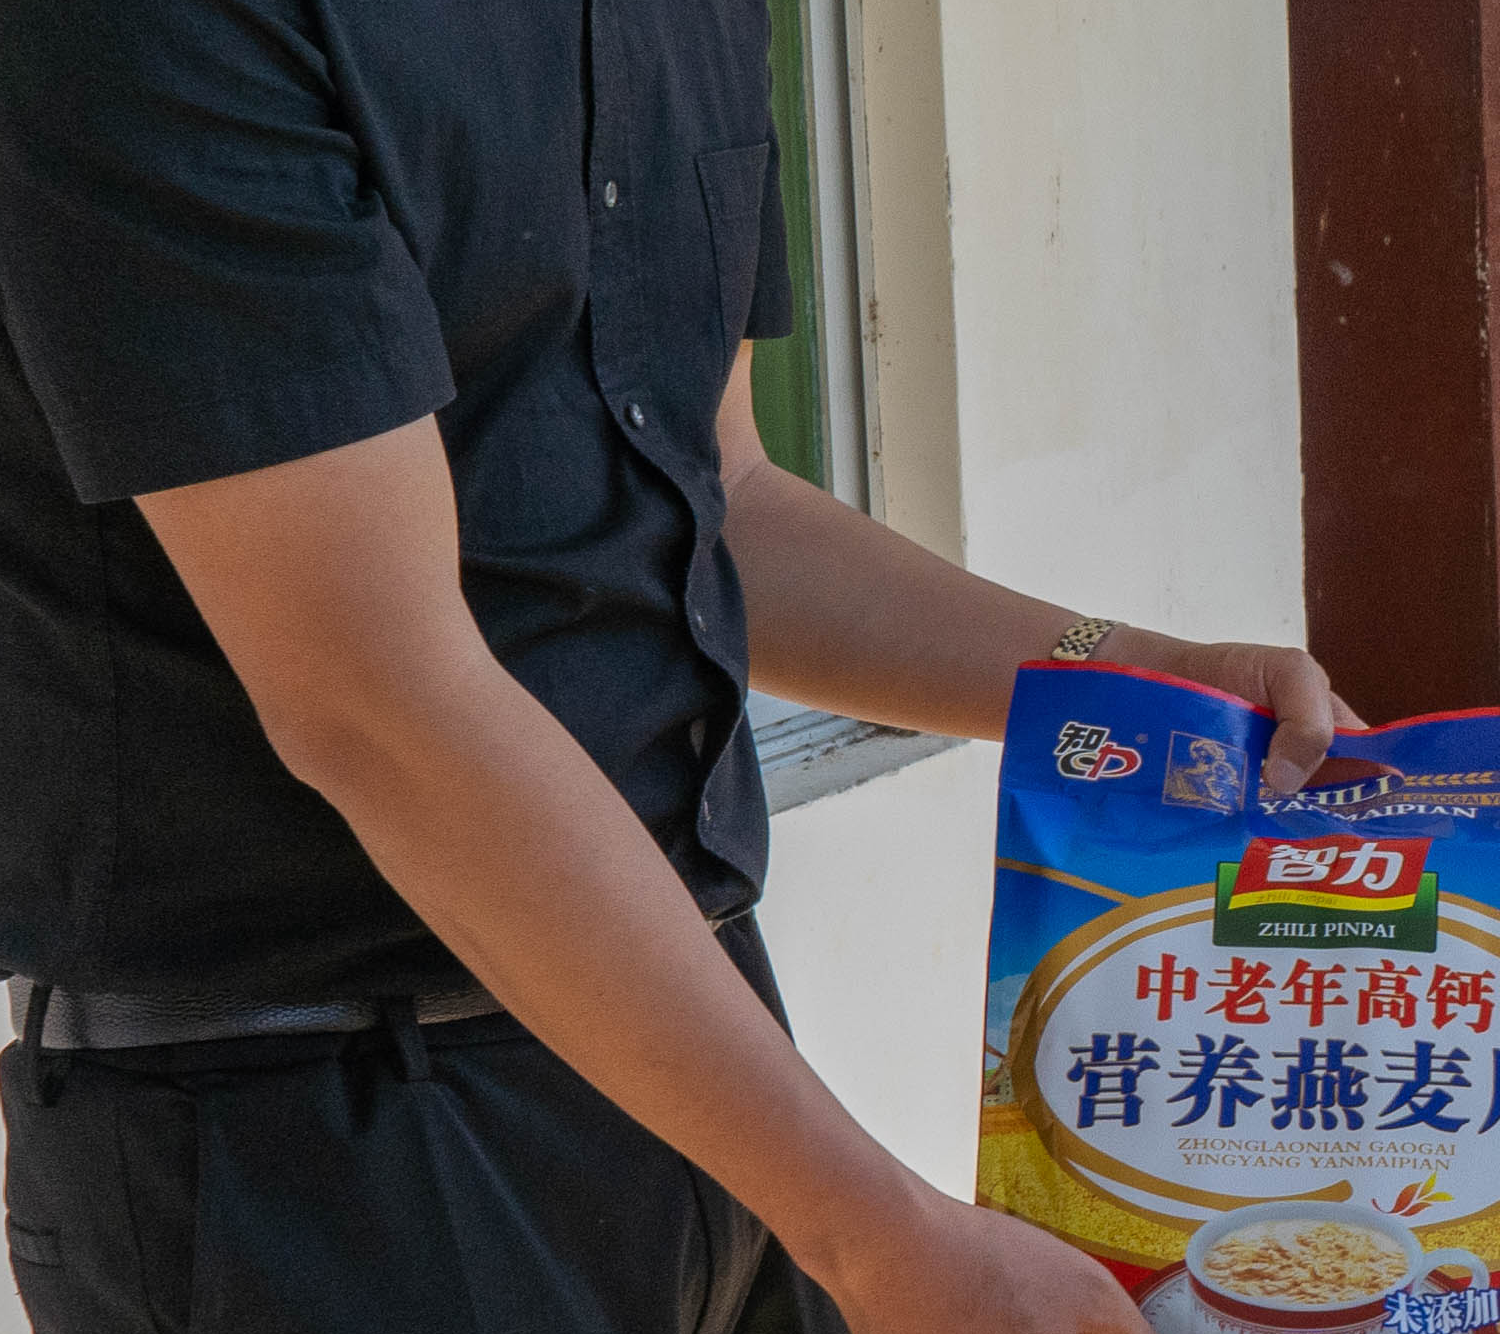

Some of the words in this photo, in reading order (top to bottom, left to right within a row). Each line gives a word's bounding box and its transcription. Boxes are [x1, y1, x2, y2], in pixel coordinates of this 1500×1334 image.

[1294, 774, 1394, 806] HILI
[1265, 842, 1405, 892] 智力
[1257, 921, 1318, 938] ZHILI
[1323, 921, 1397, 939] PINPAI
[1136, 953, 1496, 1034] 中老年高钙
[1177, 1137, 1362, 1154] ZHONGLAONIAN
[1369, 1139, 1457, 1156] GAOGAI
[1182, 1153, 1301, 1168] YINGYANG
[1310, 1155, 1451, 1171] YANMAIPIAN
